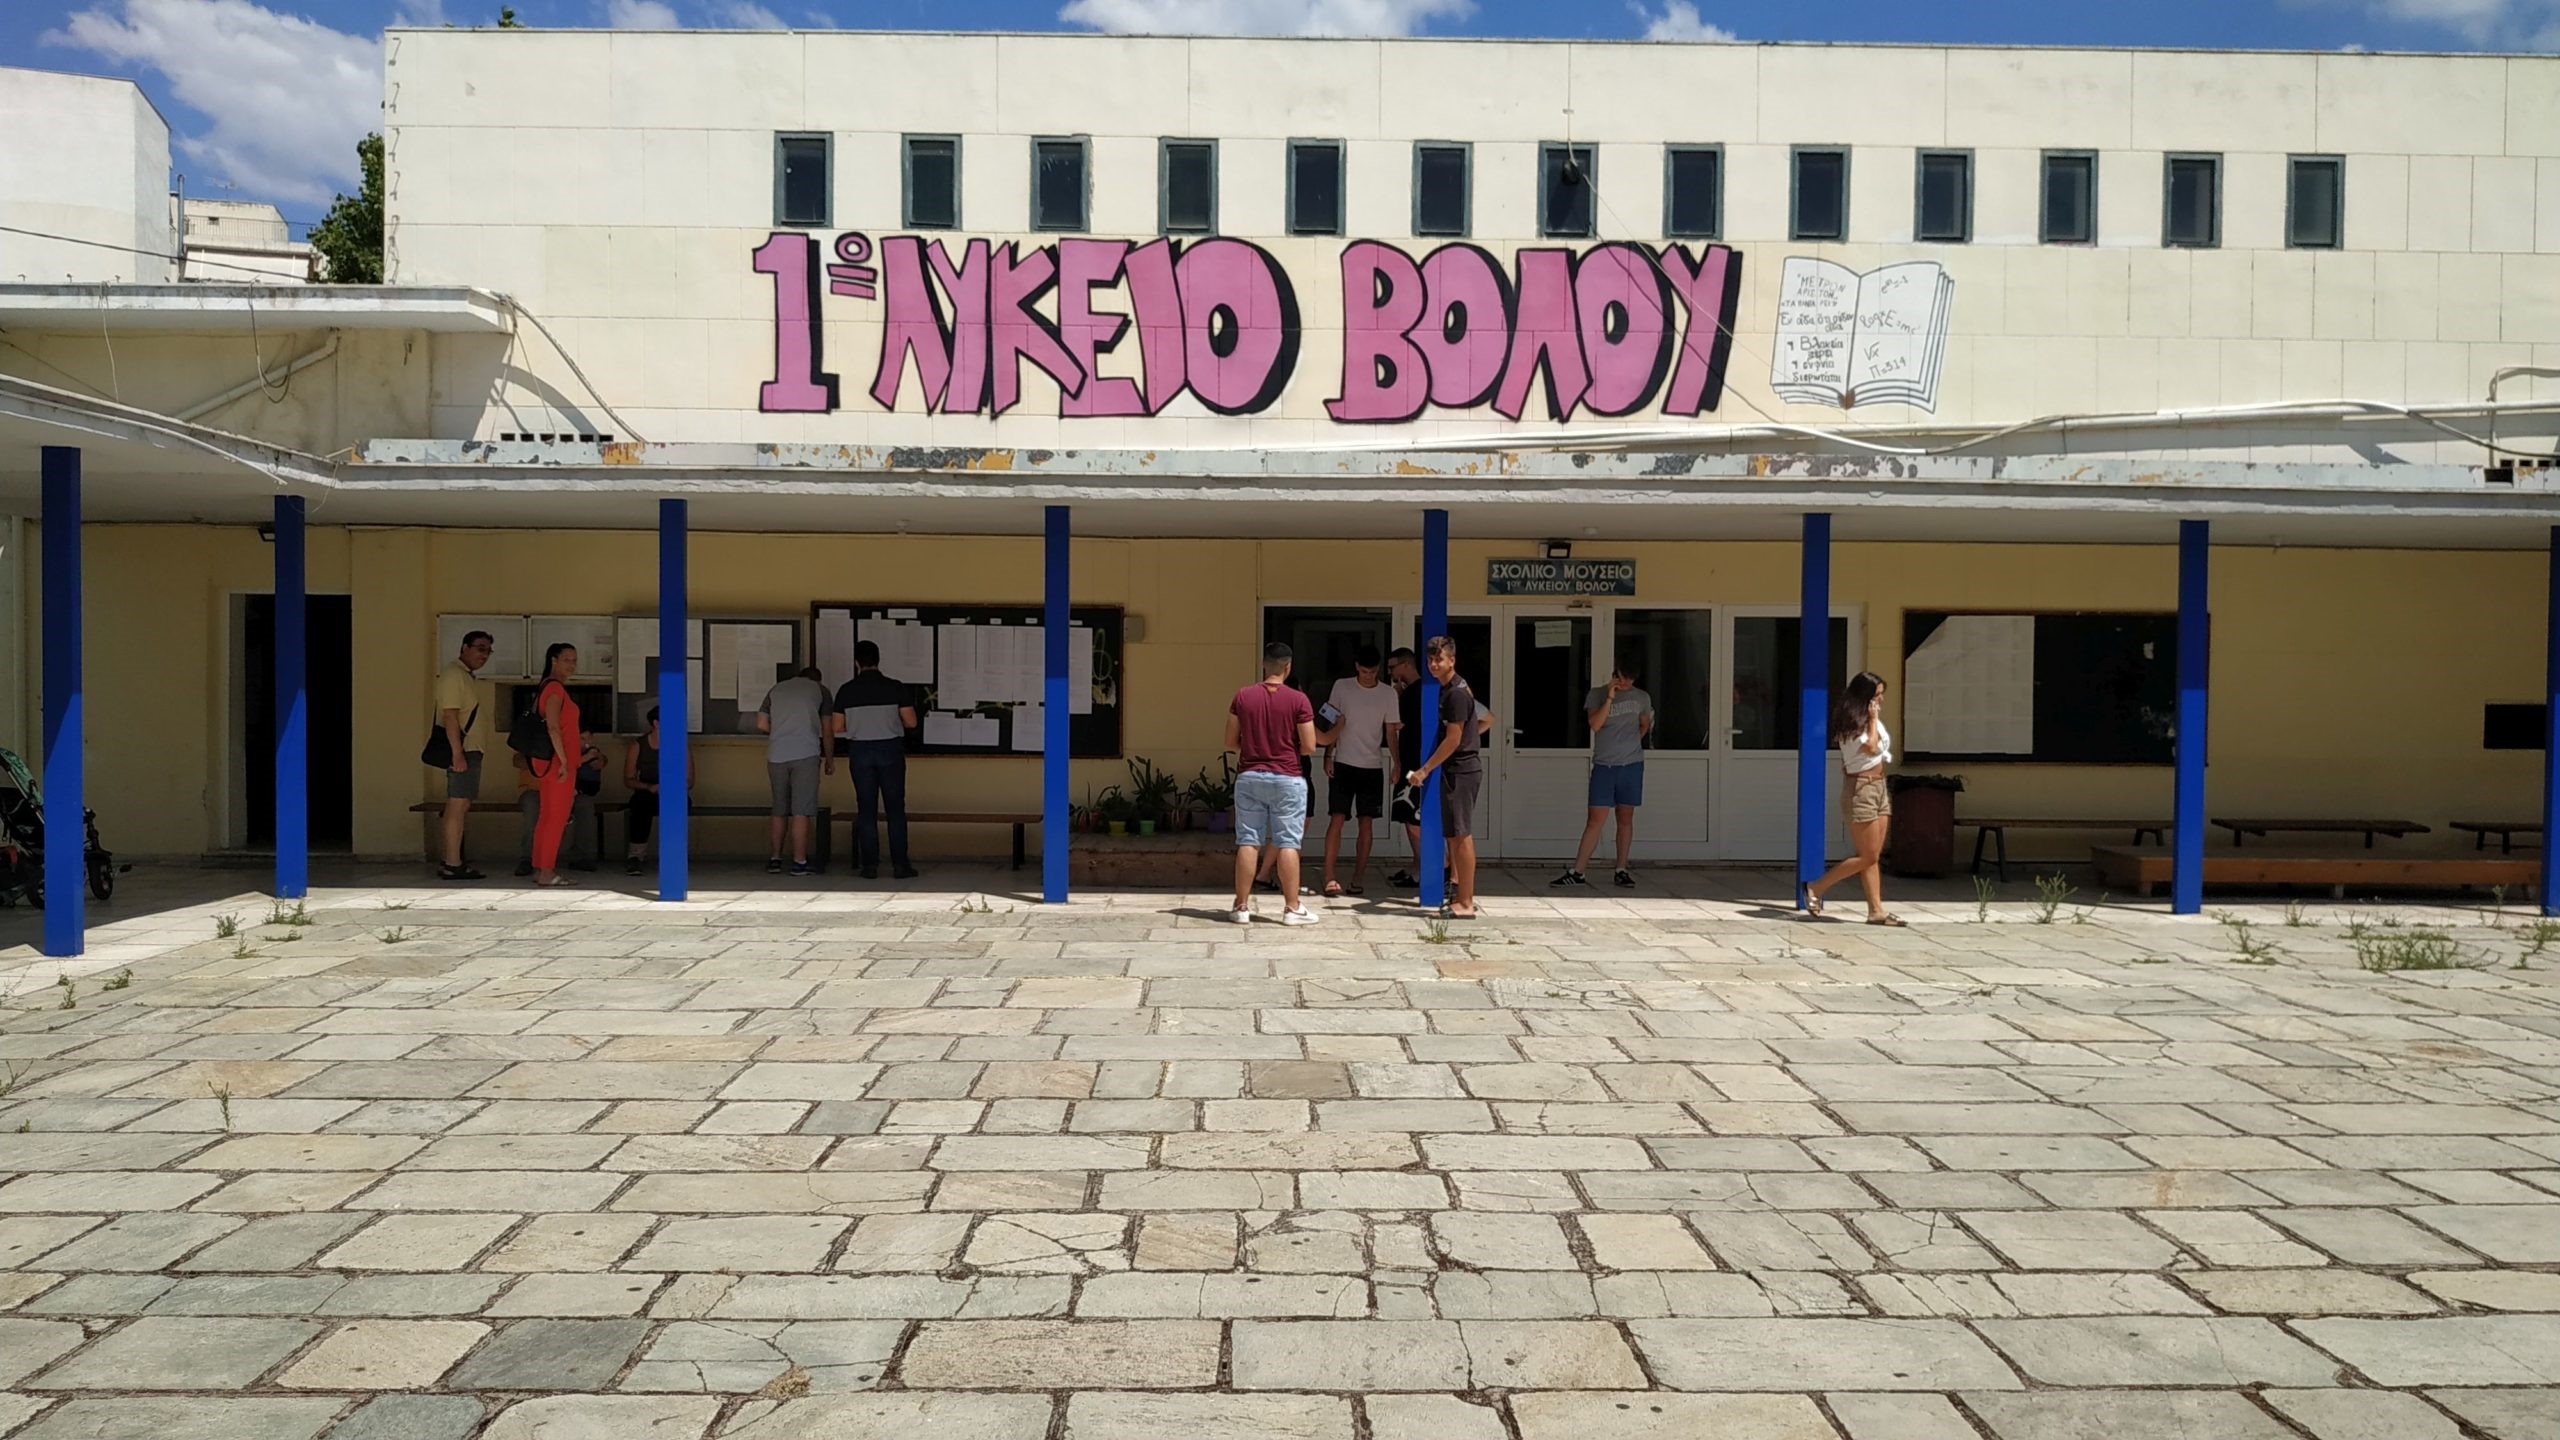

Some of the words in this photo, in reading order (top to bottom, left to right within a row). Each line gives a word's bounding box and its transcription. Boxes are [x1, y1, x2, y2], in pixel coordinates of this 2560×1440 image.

[869, 235, 1301, 419] ΛΥΚΕΙΟ
[1323, 238, 1743, 424] ΒΟΛΟΥ
[1491, 564, 1556, 579] ΣΧΟΛΙΚΟ
[1563, 565, 1633, 579] ΜΟΥΣΕΙΟ
[1524, 581, 1571, 591] ΛΥΚΕΙΟΥ
[1575, 581, 1616, 591] ΒΟΛΟΥ
